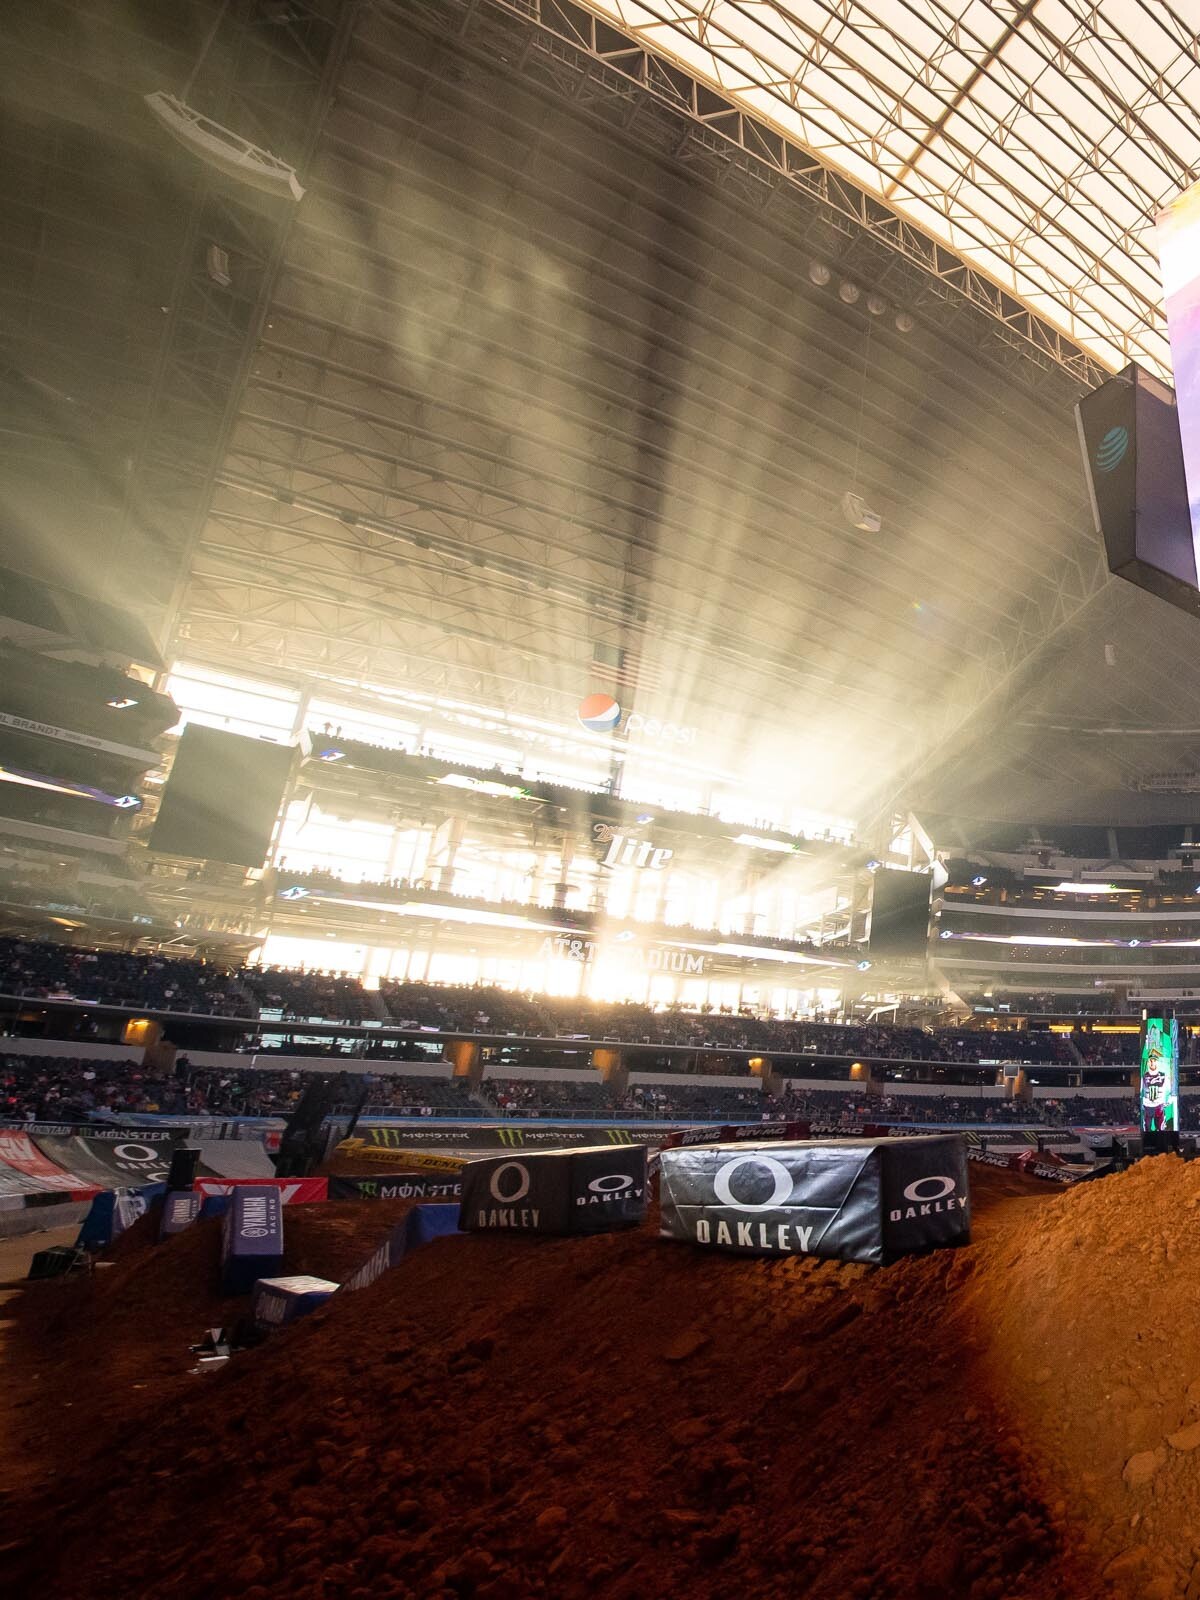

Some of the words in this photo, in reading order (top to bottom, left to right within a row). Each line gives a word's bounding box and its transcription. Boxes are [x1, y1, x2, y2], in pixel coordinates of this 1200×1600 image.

[603, 834, 675, 870] Lite
[631, 1132, 671, 1140] MONST
[115, 1161, 173, 1169] OAKLE
[423, 1158, 464, 1169] DUNLO
[381, 1182, 461, 1199] MONSTE
[576, 1188, 644, 1207] OAKLEY
[243, 1196, 266, 1229] YAMAHA
[477, 1208, 541, 1229] OAKLEY
[888, 1196, 968, 1222] OAKLEY
[696, 1218, 815, 1252] OAKLEY
